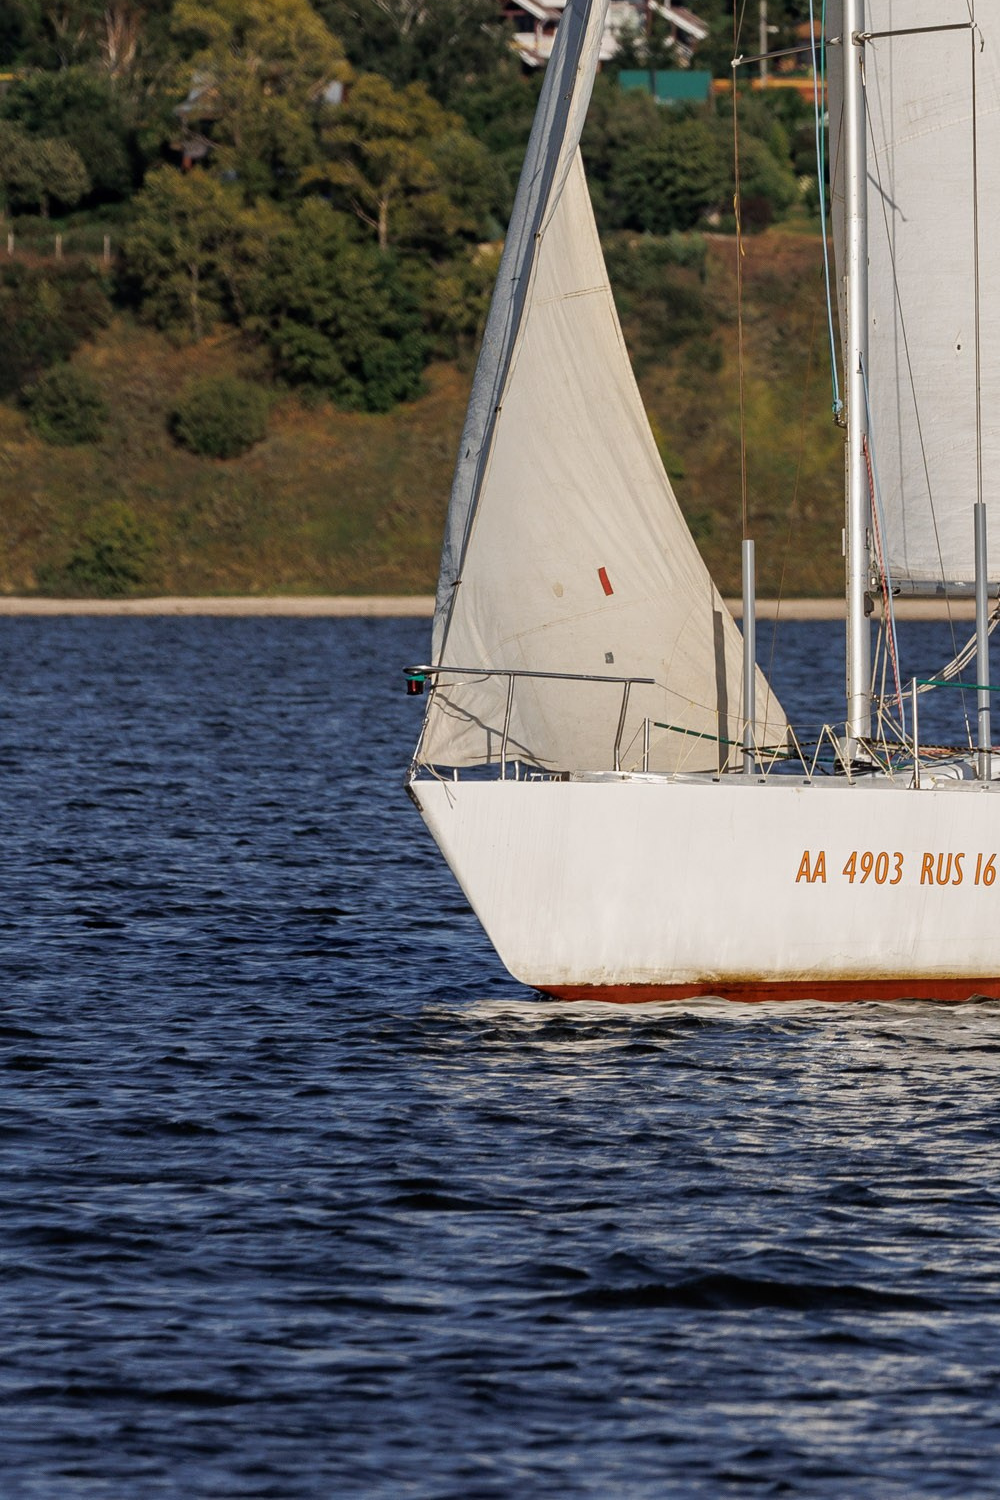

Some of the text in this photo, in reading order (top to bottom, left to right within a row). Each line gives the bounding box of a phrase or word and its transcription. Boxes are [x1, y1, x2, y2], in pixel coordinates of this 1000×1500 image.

[795, 850, 997, 886] AA 4903 RUS 16
